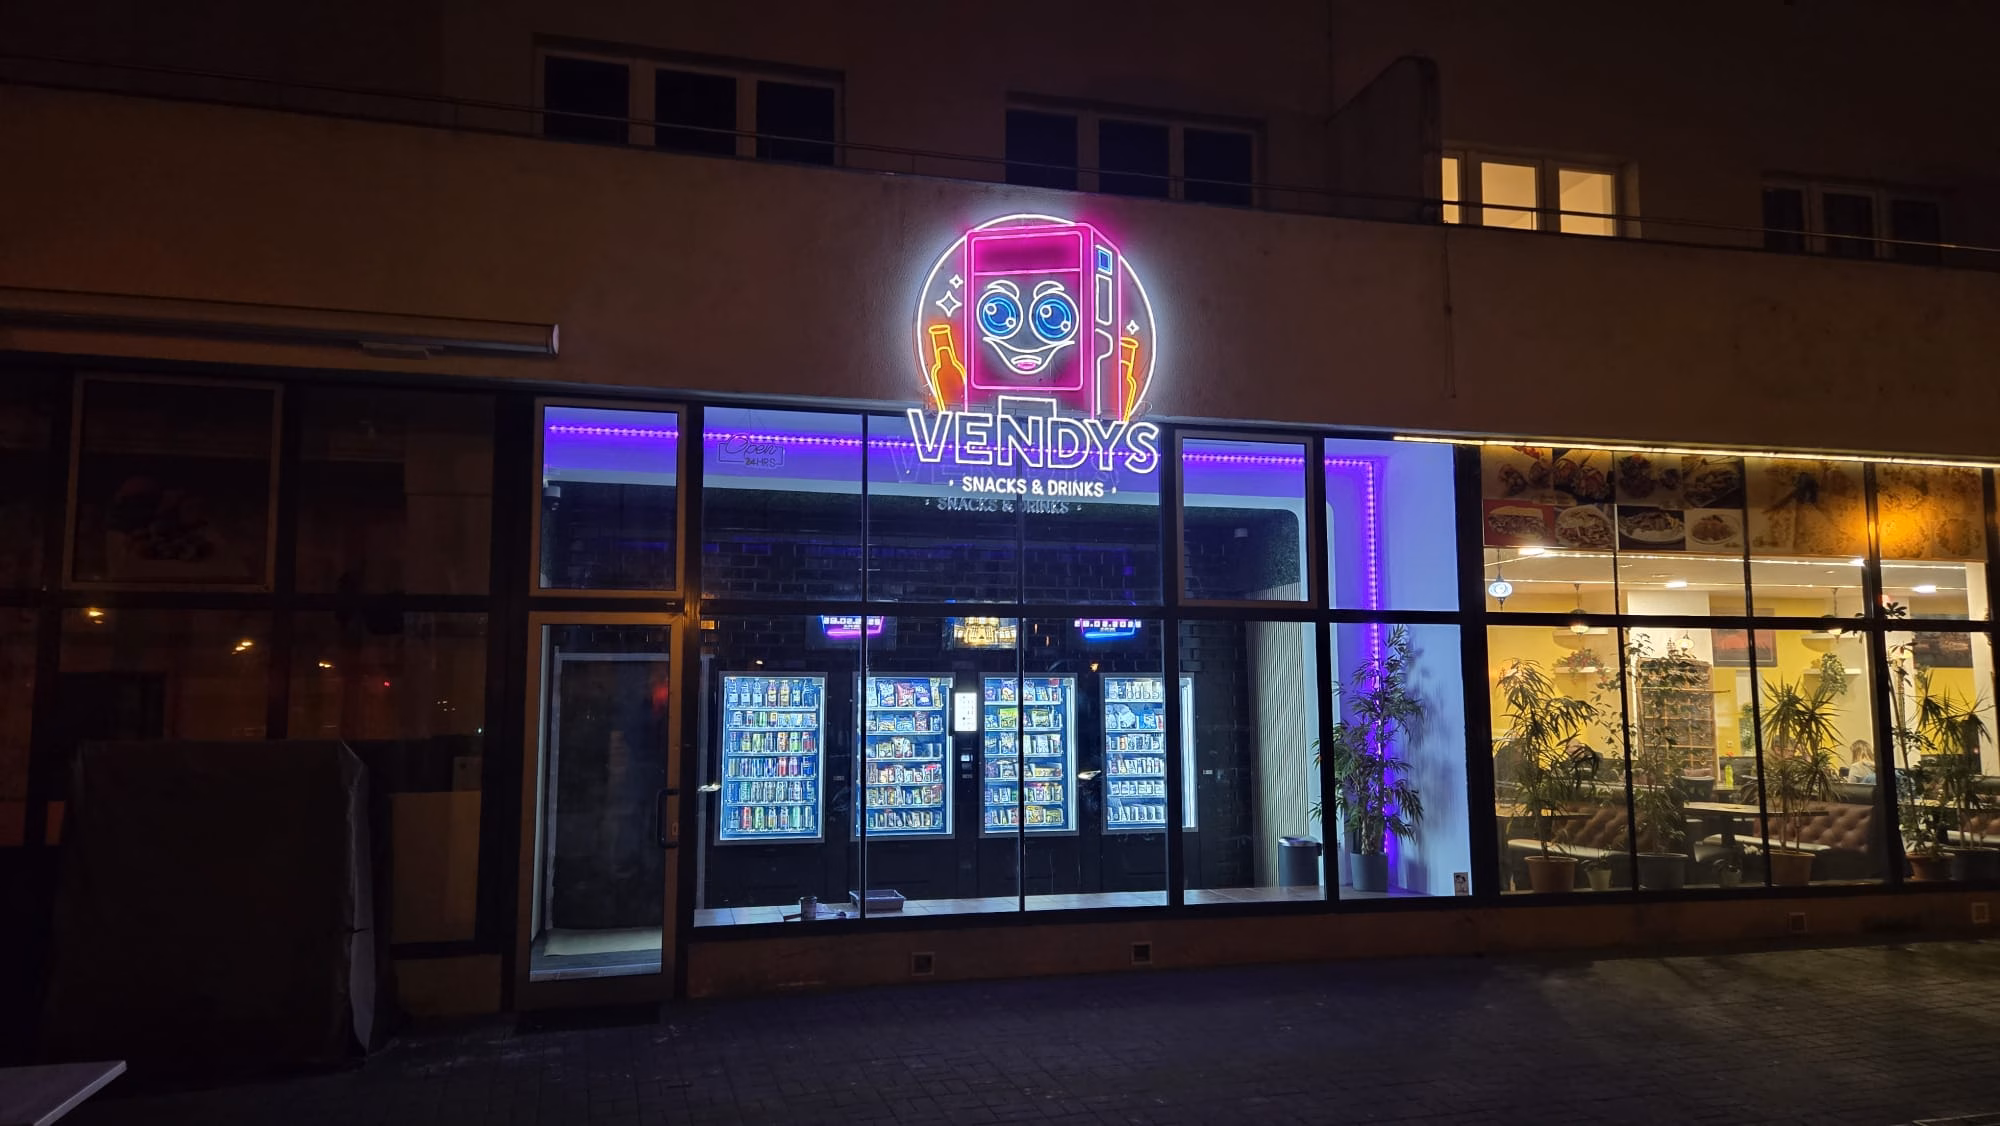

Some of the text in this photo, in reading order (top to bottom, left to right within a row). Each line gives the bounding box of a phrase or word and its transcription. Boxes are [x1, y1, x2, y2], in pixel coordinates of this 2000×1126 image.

[726, 434, 776, 457] Open
[907, 408, 1159, 474] VENDYS
[962, 476, 1104, 497] SNACKS & DRINKS
